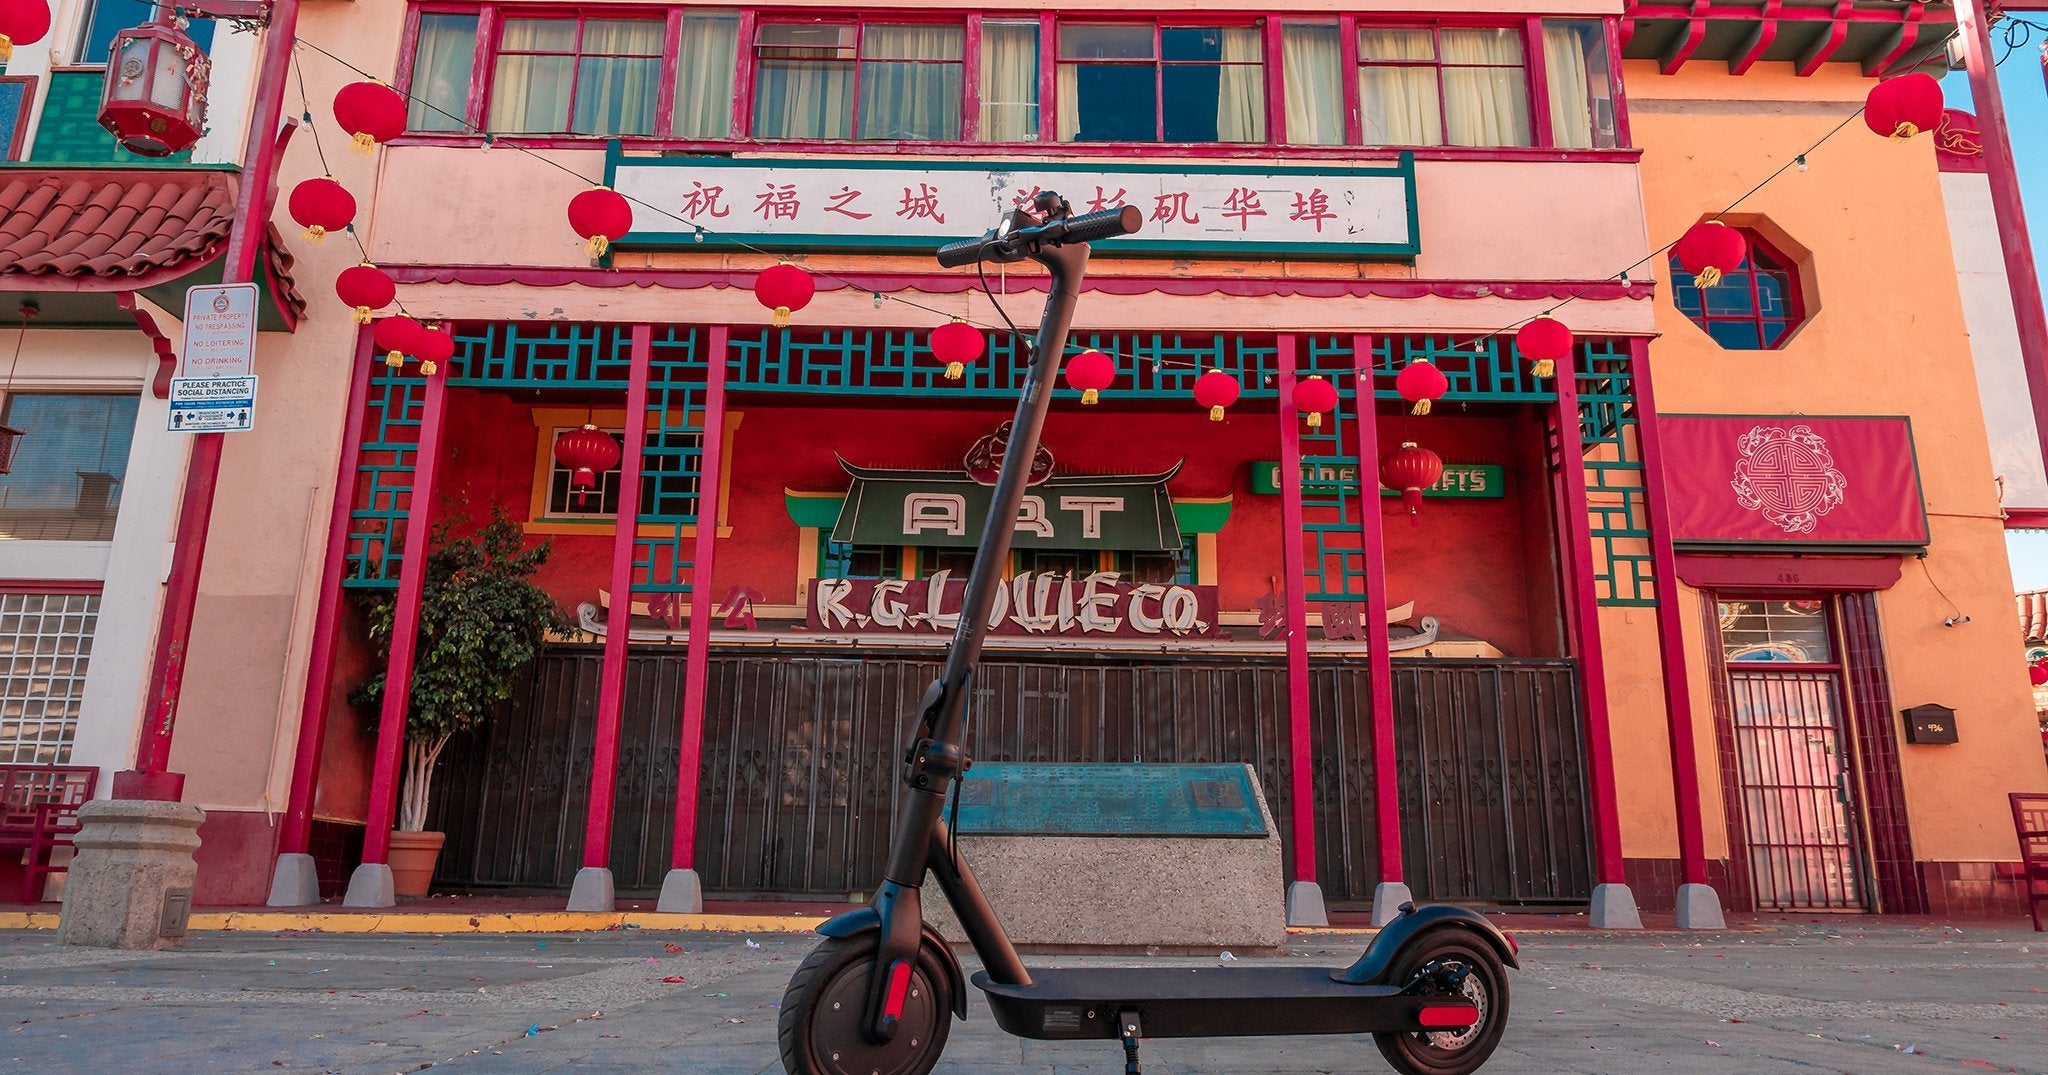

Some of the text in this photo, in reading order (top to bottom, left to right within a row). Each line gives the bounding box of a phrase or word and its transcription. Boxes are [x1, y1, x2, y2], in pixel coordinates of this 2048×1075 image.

[680, 180, 945, 225] 祝福之城
[206, 322, 246, 330] TRESPASSING
[206, 339, 244, 347] LOITERING
[205, 357, 243, 365] DRINKING
[182, 380, 247, 389] PLEASE PRACTICE
[206, 388, 250, 396] DISTANCING
[1432, 470, 1487, 491] FTS
[902, 492, 1124, 539] ART
